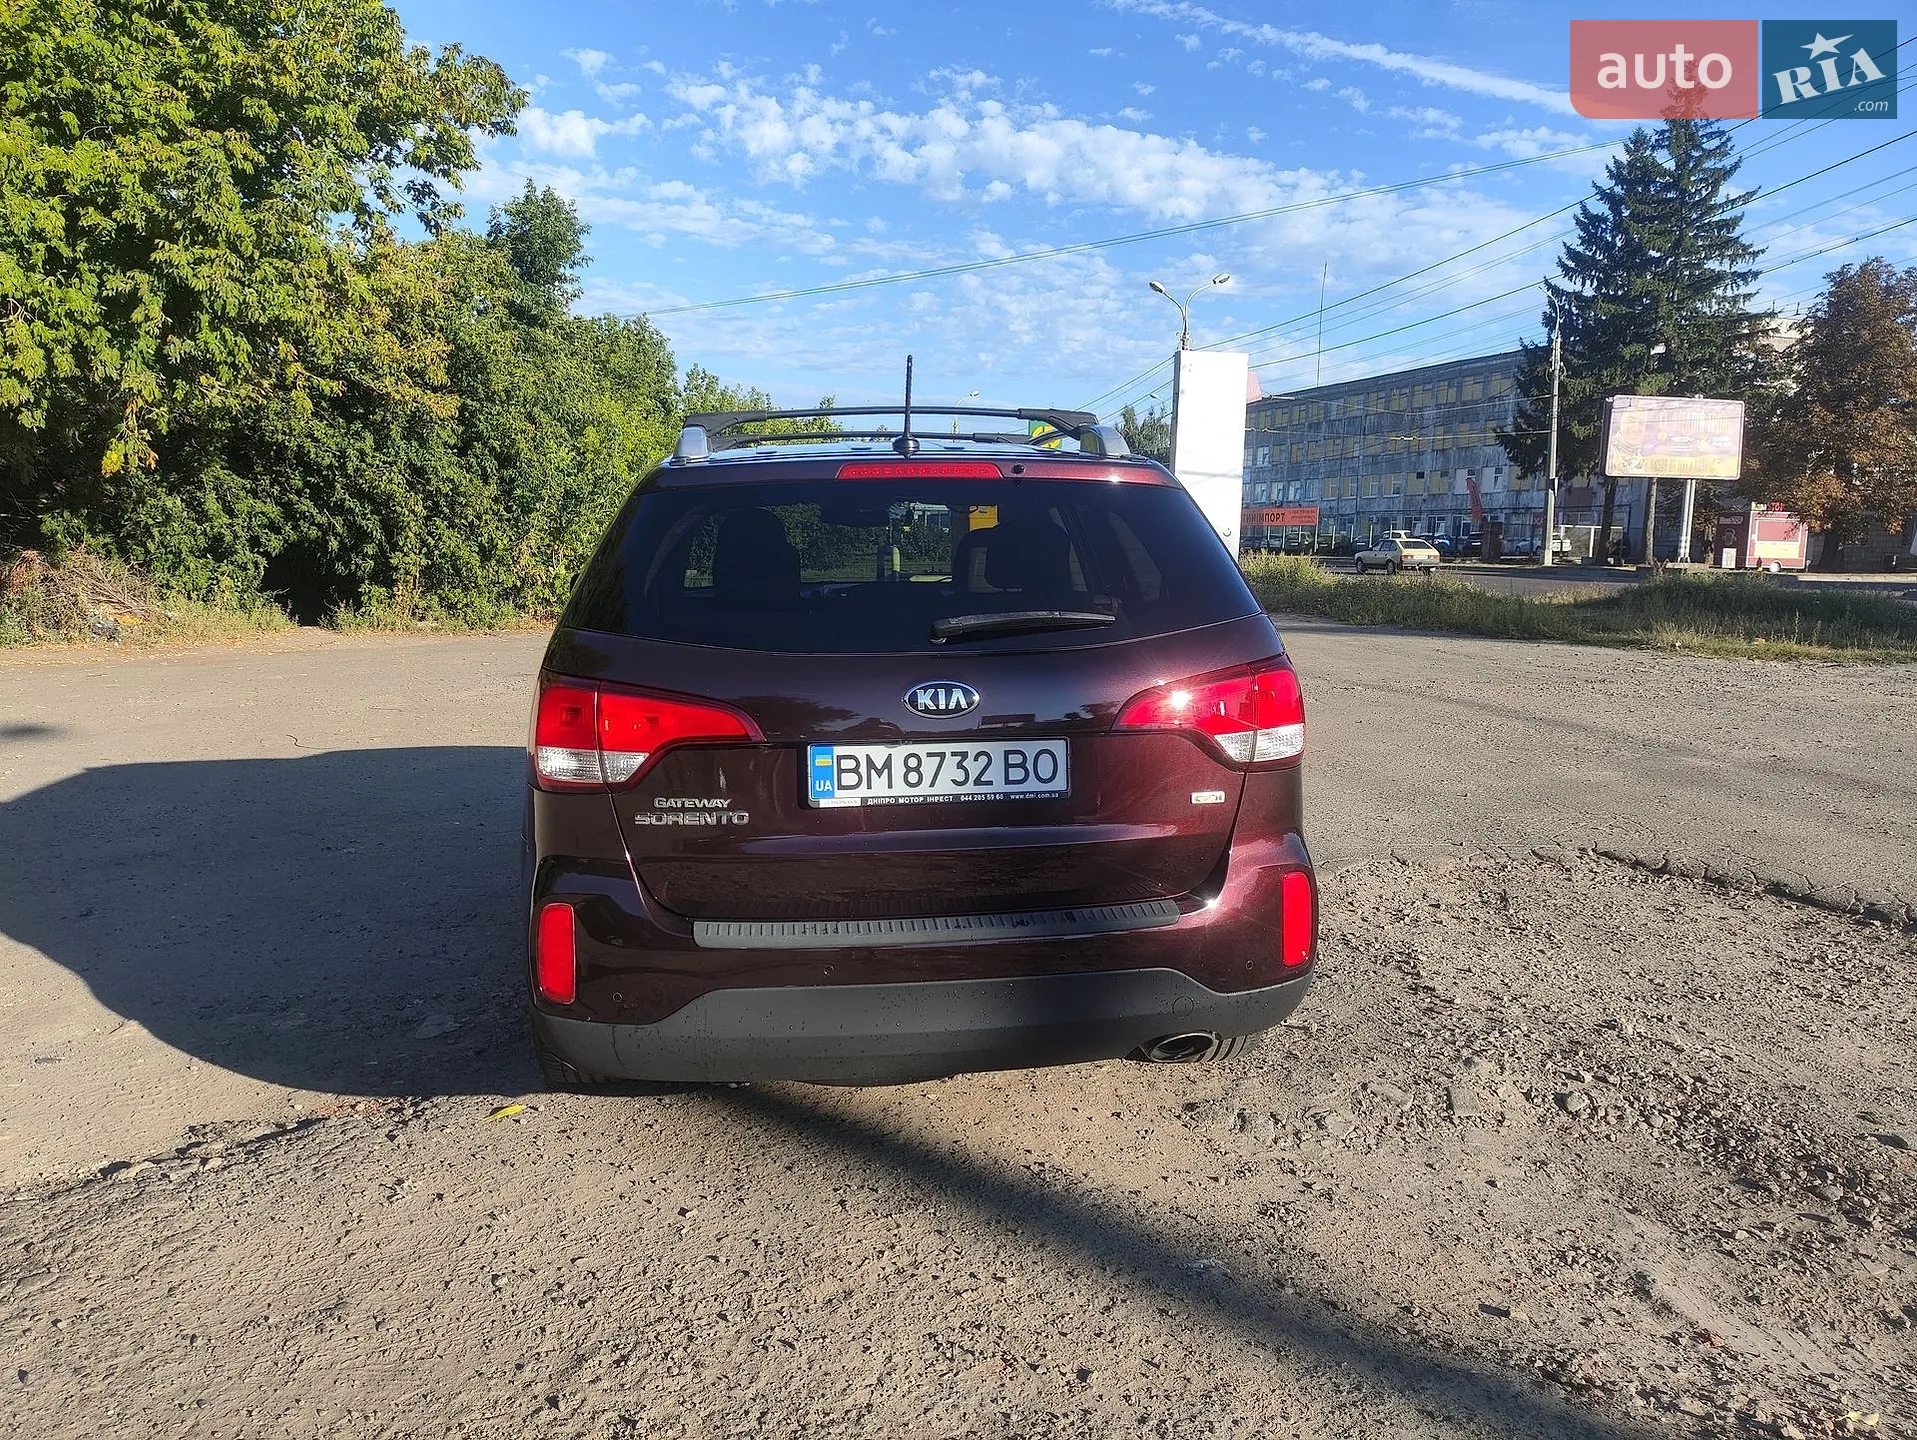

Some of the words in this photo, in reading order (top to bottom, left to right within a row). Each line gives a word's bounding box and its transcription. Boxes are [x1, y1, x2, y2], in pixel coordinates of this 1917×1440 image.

[916, 688, 969, 710] KIA
[836, 753, 894, 790] BM
[903, 751, 994, 788] 8732
[1003, 748, 1059, 786] BO
[815, 780, 833, 792] UA
[653, 797, 732, 808] GATEWAY
[898, 796, 924, 804] МОТОР
[634, 810, 750, 826] SORENTO
